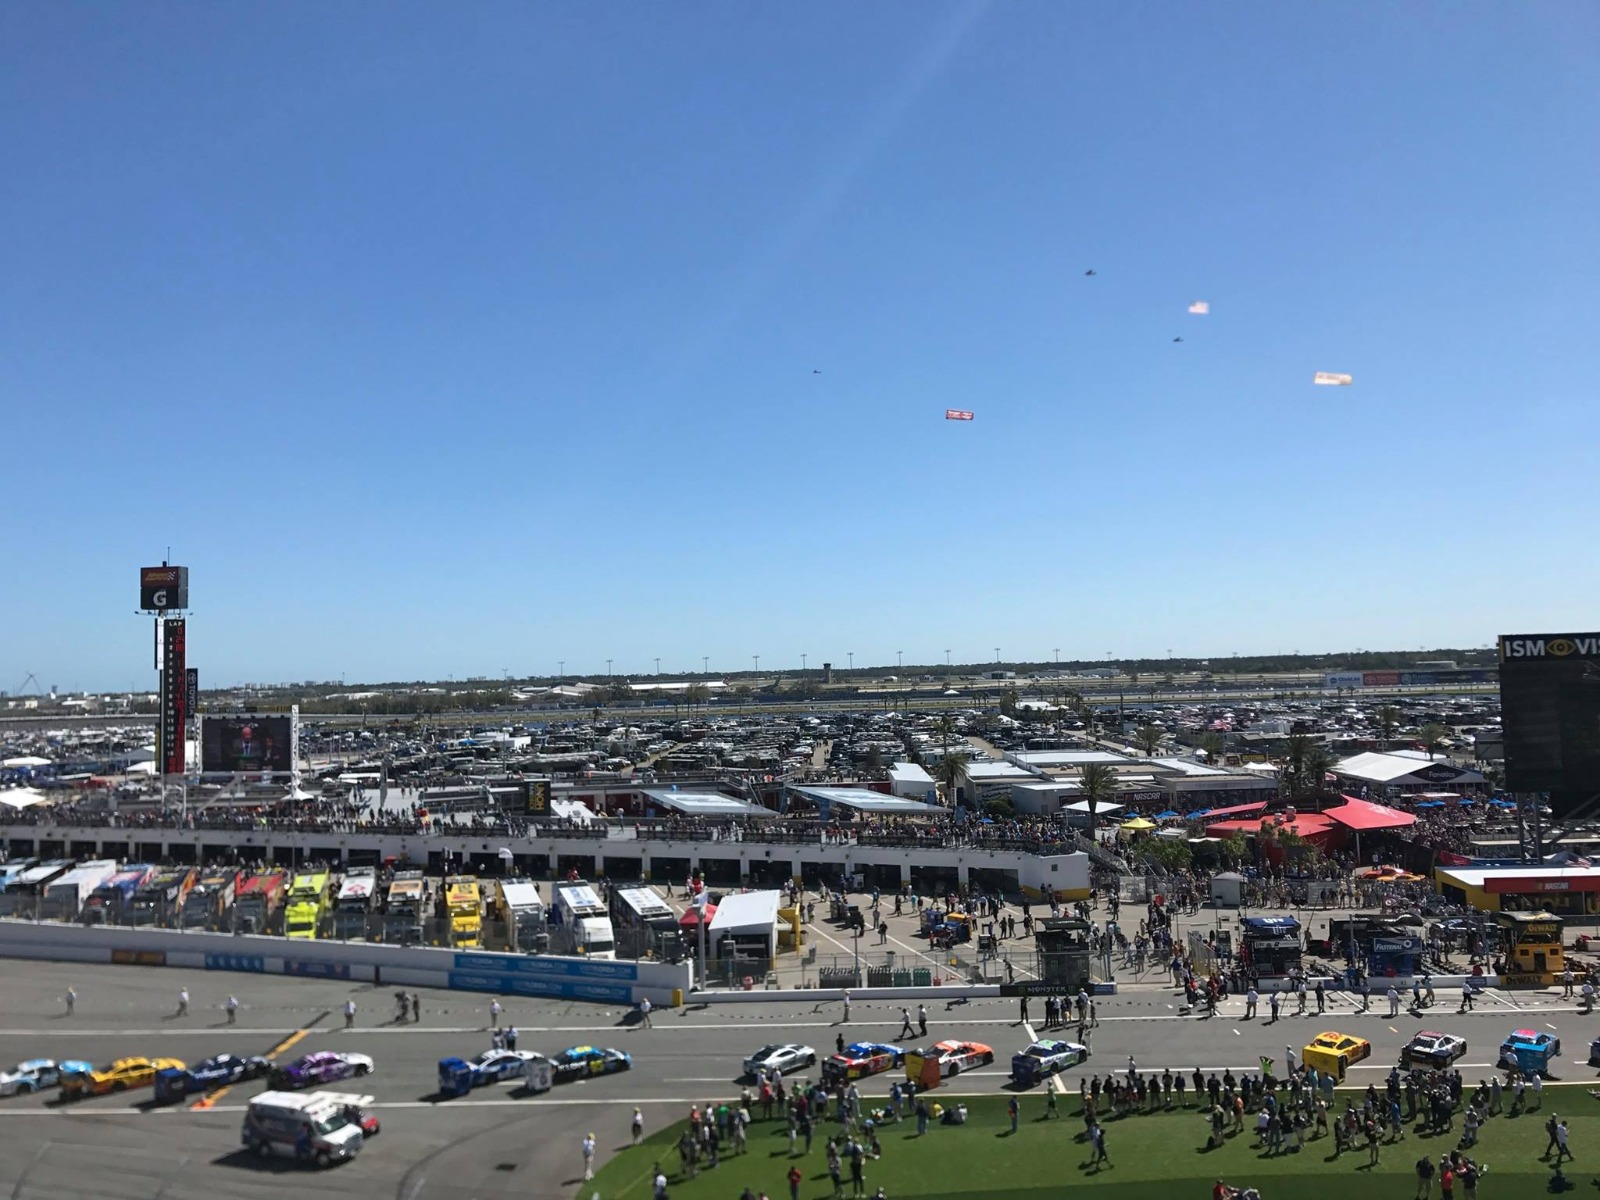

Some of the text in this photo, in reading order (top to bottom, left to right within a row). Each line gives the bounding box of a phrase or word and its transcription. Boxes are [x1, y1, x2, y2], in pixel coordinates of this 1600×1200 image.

[153, 590, 167, 607] G
[1504, 638, 1600, 657] ISM VI
[188, 685, 196, 715] TOYOTA
[1428, 770, 1456, 778] Fanatics
[536, 782, 545, 811] UNOH
[1133, 792, 1161, 801] NASCAR
[1544, 882, 1569, 890] NASCAR
[1375, 943, 1403, 951] FASTENAL
[1027, 985, 1067, 993] MONSTER
